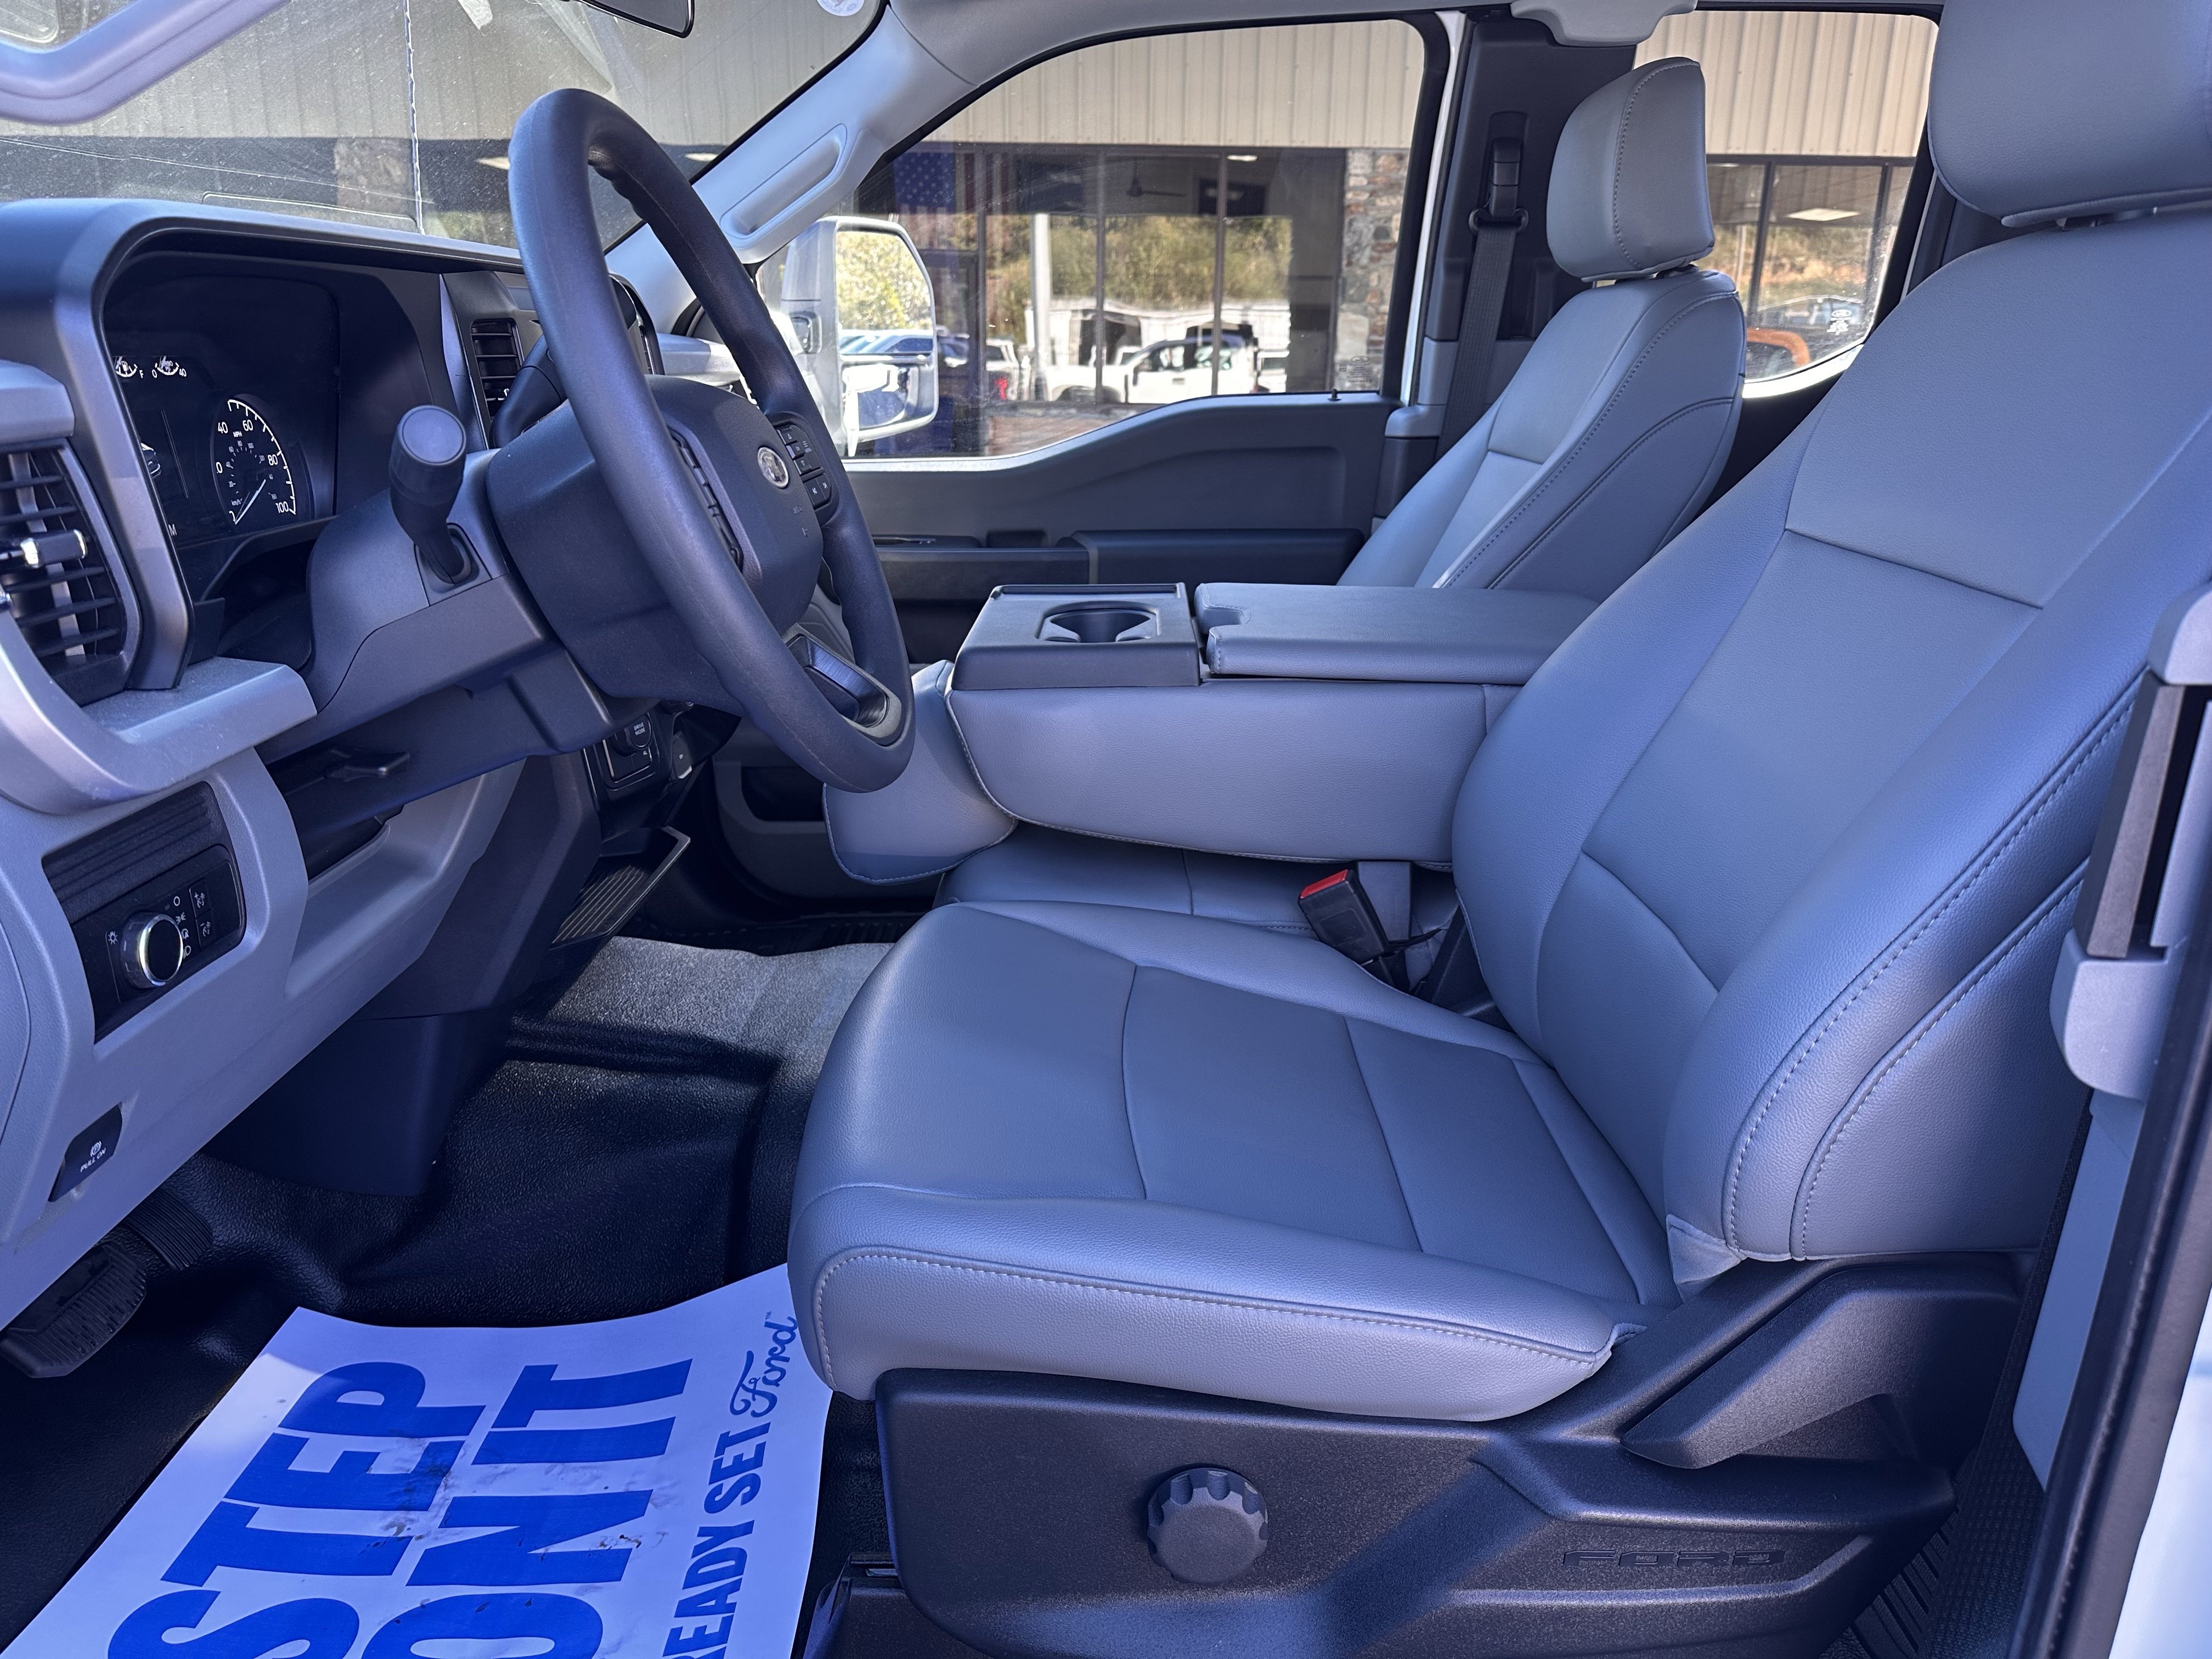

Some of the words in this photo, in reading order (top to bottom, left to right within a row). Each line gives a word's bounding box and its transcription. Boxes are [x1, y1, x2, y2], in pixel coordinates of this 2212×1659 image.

[139, 370, 144, 379] F
[179, 368, 187, 377] 40
[218, 421, 228, 433] 40
[242, 419, 253, 431] 60
[267, 454, 278, 466] 80
[275, 501, 289, 514] 100
[633, 721, 645, 731] DRIVE
[635, 727, 646, 736] MODE
[80, 1156, 96, 1173] PULL
[97, 1147, 106, 1159] ON
[730, 1316, 799, 1418] Ford
[473, 1358, 693, 1464] IT
[703, 1421, 771, 1514] SET
[108, 1361, 487, 1659] STEP
[1563, 1549, 1786, 1567] FORD
[662, 1520, 755, 1659] EADY
